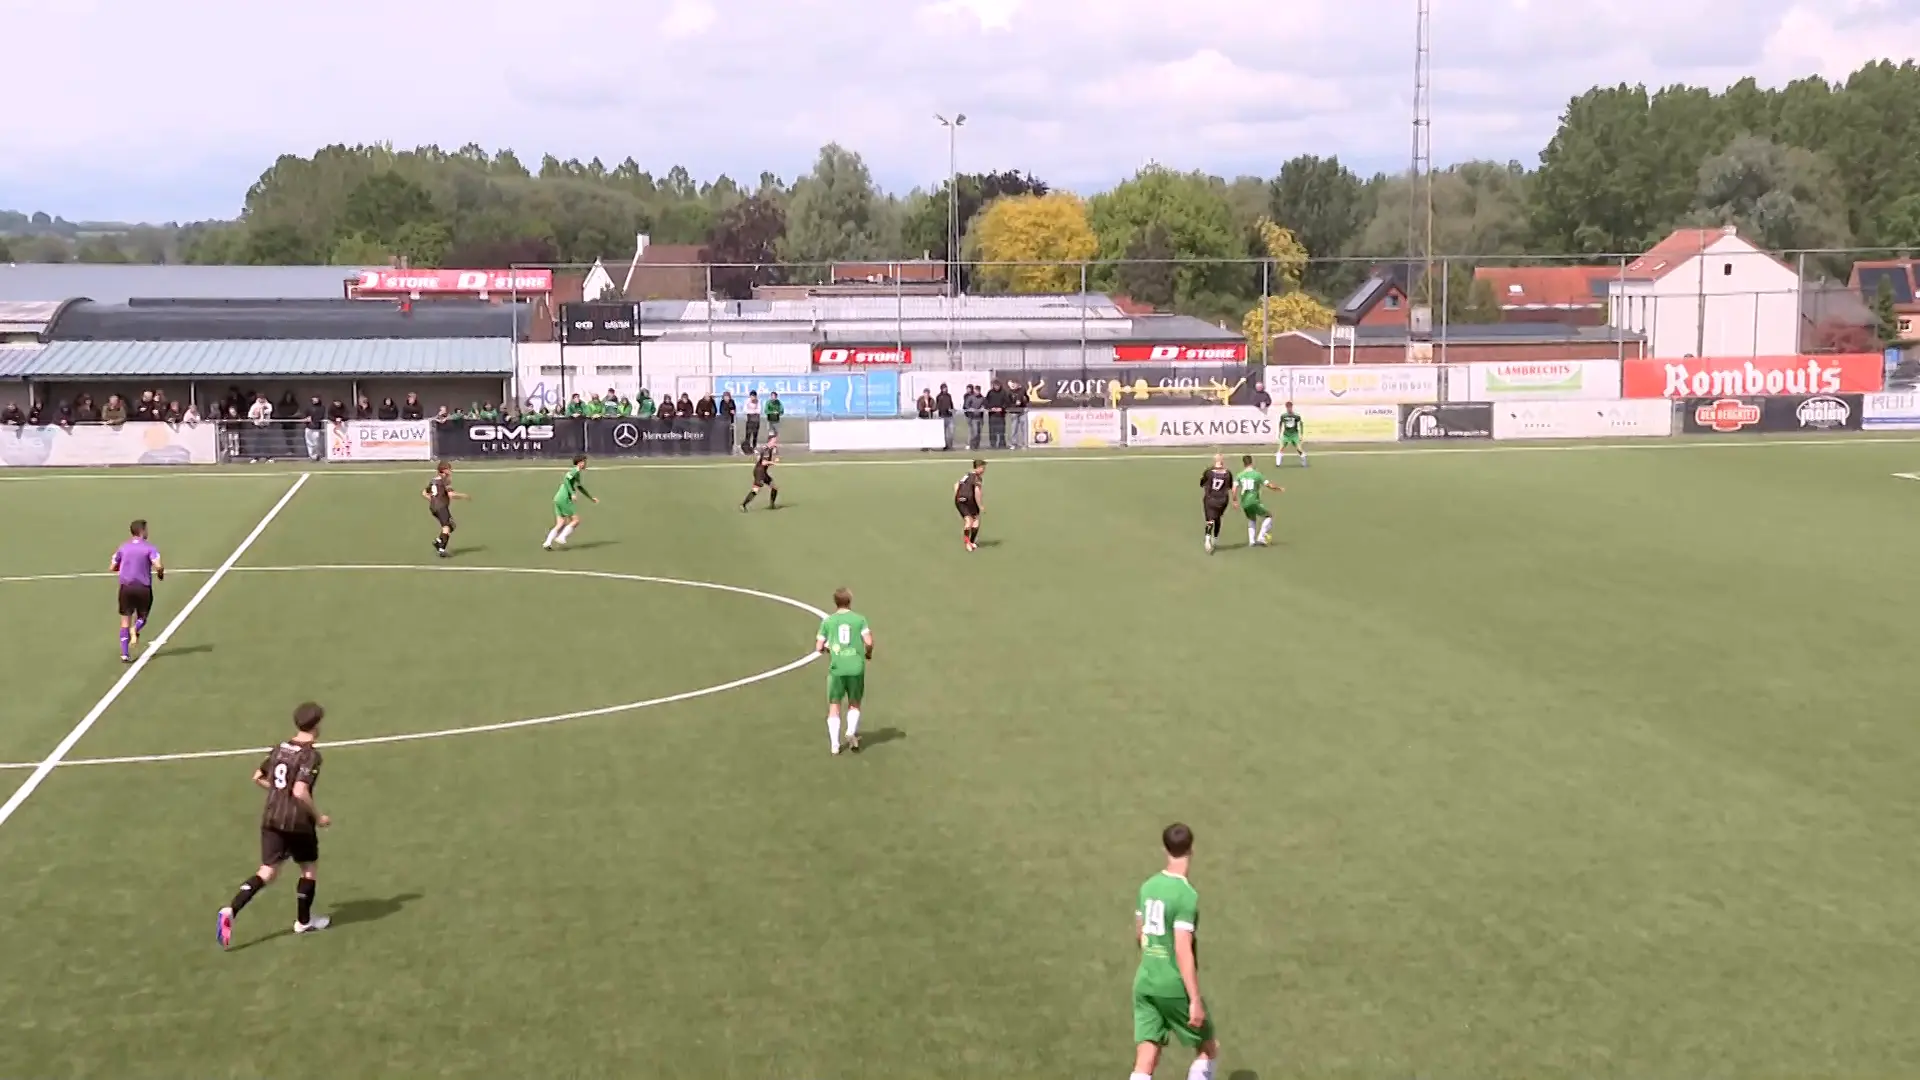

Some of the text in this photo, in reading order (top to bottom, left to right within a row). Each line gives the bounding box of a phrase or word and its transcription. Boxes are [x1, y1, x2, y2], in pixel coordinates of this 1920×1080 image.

[1497, 364, 1570, 376] LAMBRECHTS
[1663, 359, 1842, 398] Rombouts
[359, 428, 426, 440] DE PAUW
[469, 425, 554, 440] GMS
[1160, 419, 1271, 436] ALEX MOEYS
[482, 442, 541, 451] LEUVEN
[274, 763, 288, 790] 9
[1142, 899, 1166, 936] 19
